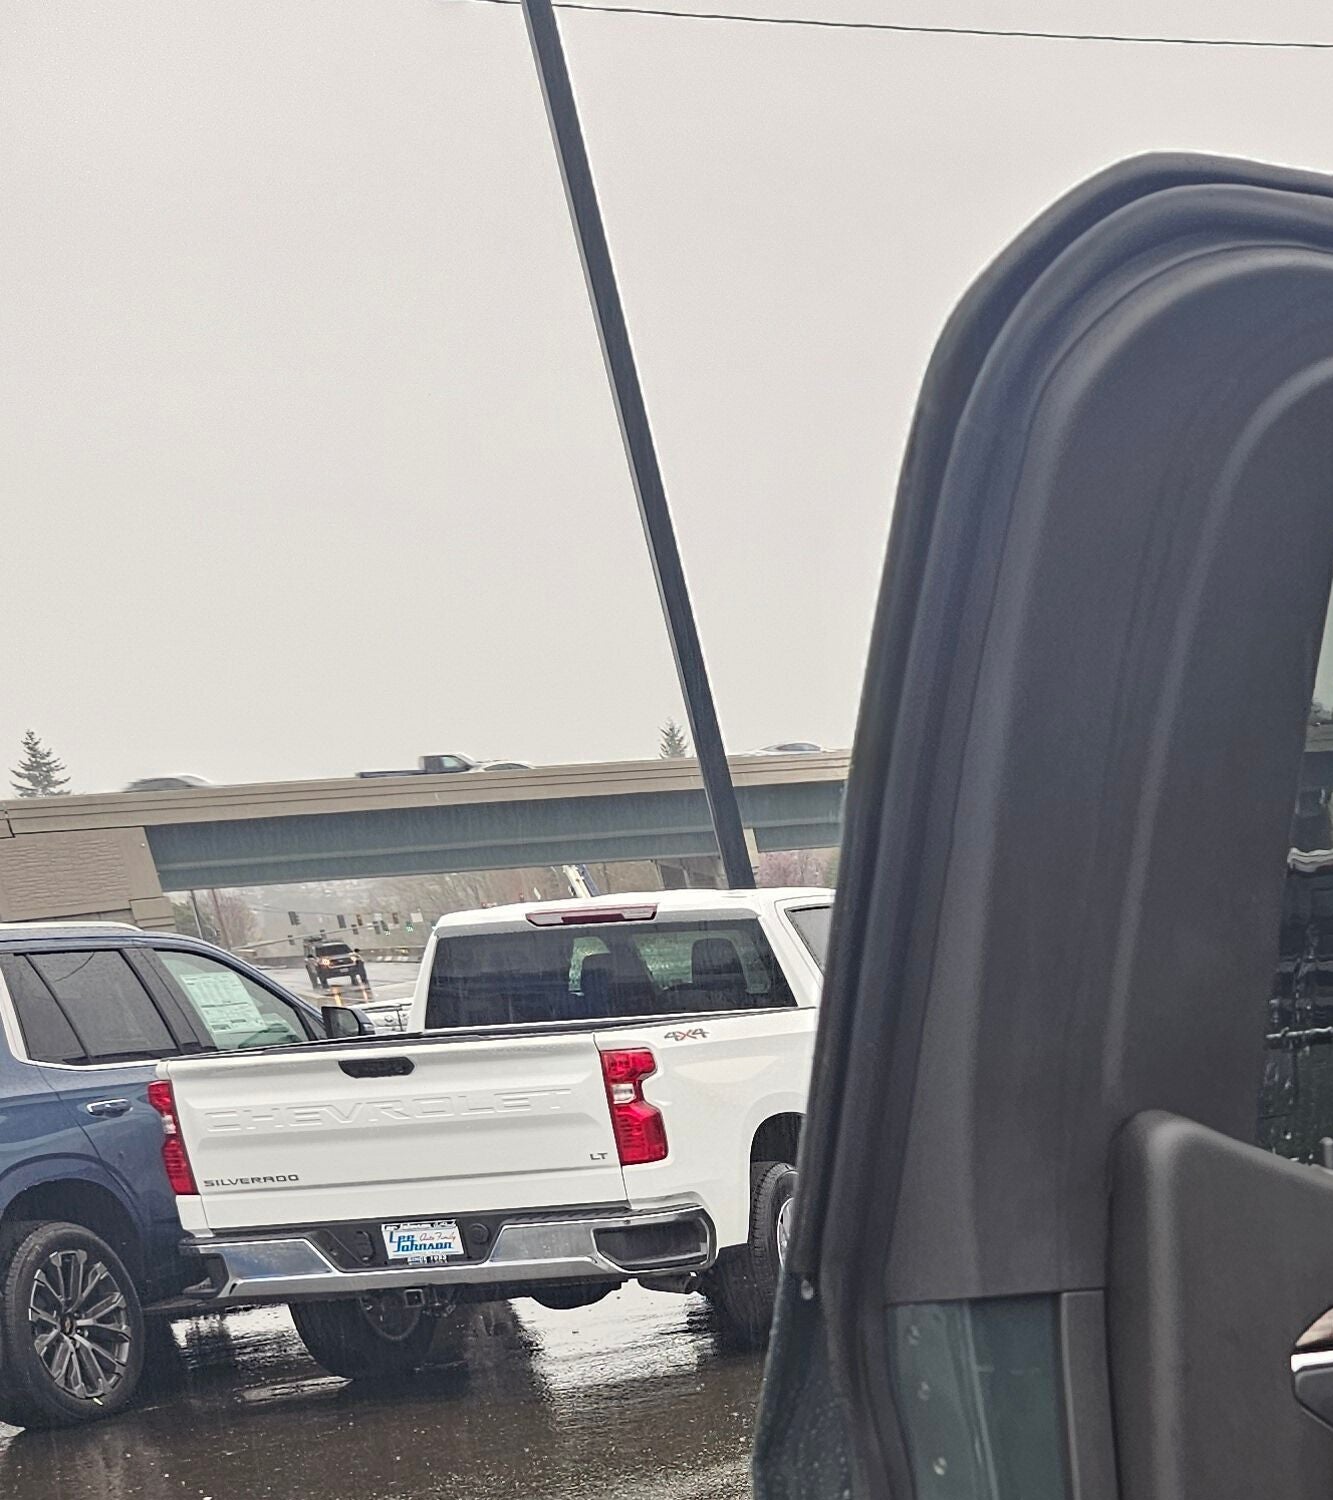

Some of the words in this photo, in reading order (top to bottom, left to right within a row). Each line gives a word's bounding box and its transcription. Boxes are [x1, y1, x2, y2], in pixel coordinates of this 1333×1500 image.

[204, 1088, 572, 1132] CHEVROLET
[590, 1152, 608, 1161] LT
[203, 1173, 300, 1187] SILVERADO
